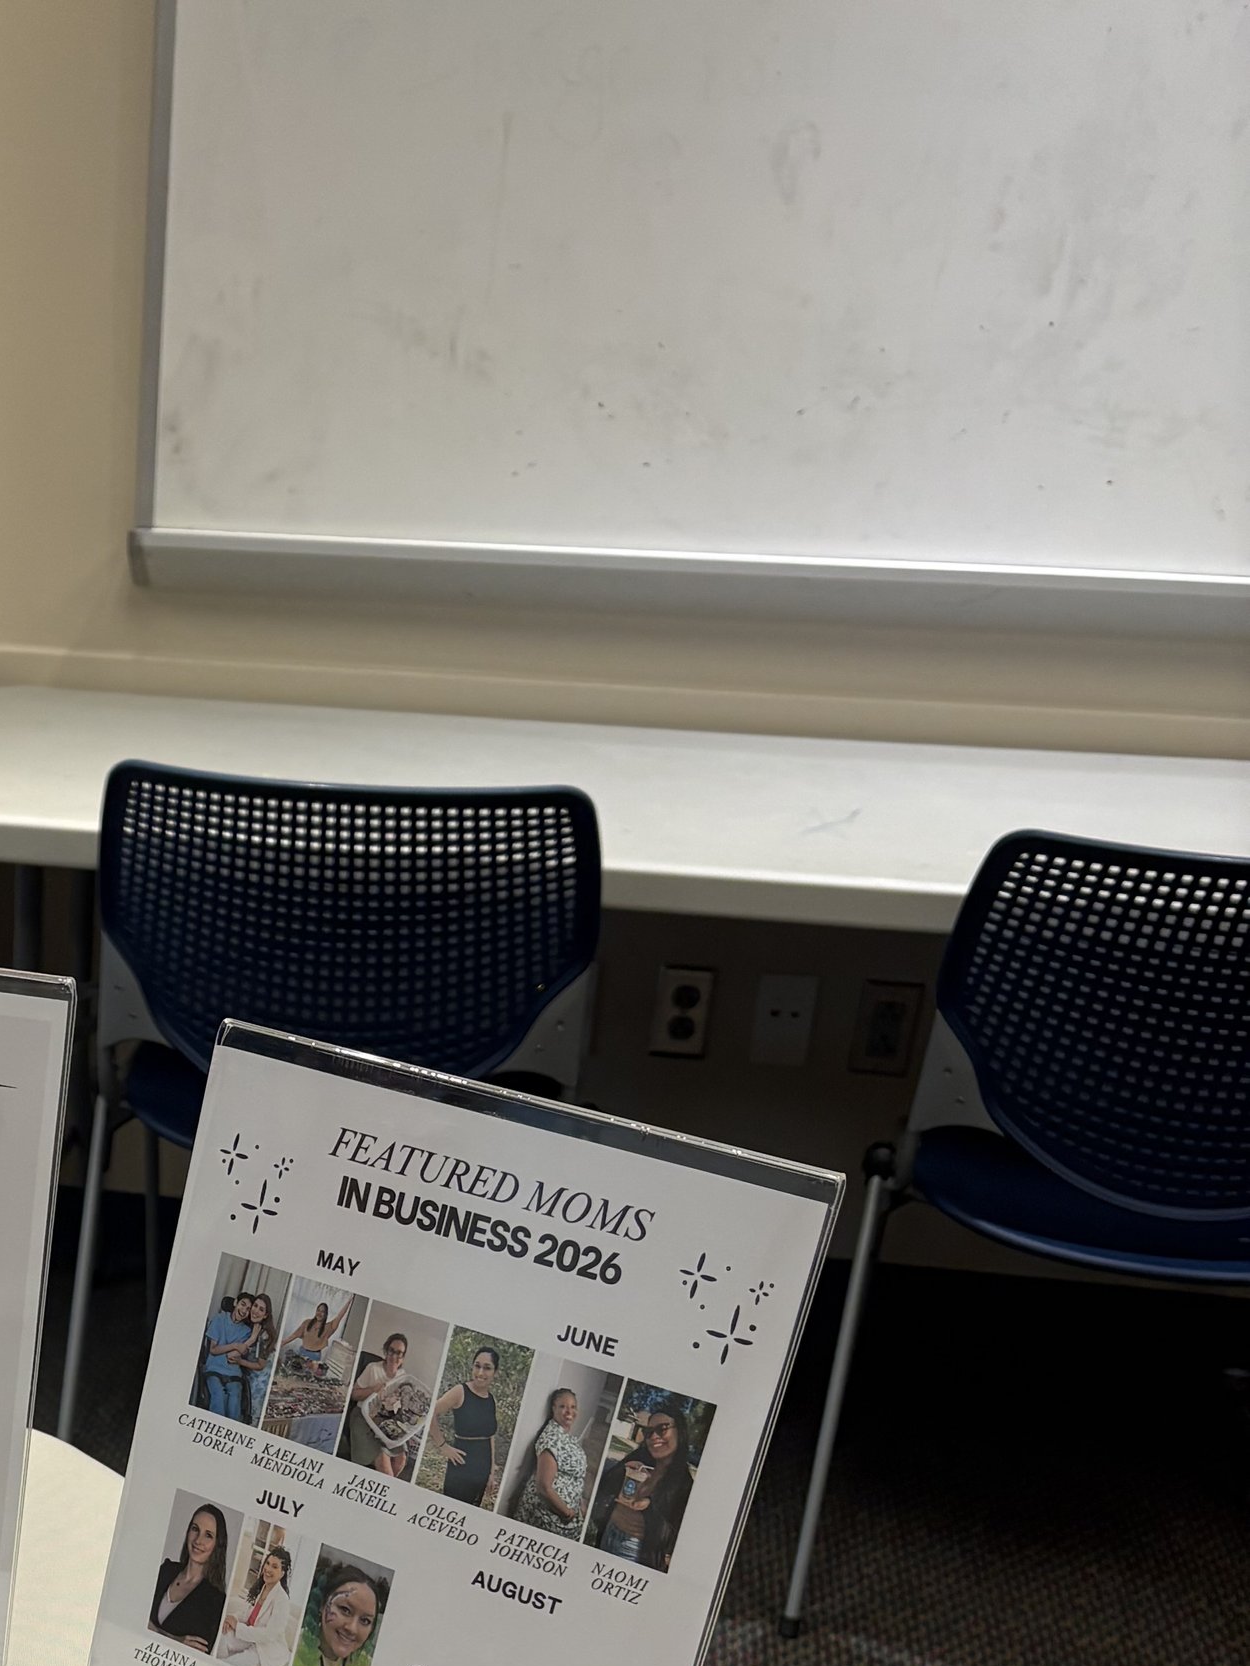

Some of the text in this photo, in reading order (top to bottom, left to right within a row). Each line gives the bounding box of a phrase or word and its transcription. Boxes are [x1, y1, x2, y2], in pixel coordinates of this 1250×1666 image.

[327, 1126, 656, 1242] FEATURED MOMS
[336, 1175, 622, 1285] IN BUSINESS 2026
[316, 1249, 361, 1277] MAY
[556, 1324, 619, 1357] JUNE
[178, 1413, 256, 1450] CATHERINE
[191, 1431, 234, 1456] DORIA
[249, 1453, 325, 1489] MENDIOLA
[261, 1442, 324, 1474] KAELANI
[331, 1482, 397, 1516] MCNEILL
[347, 1474, 390, 1497] JASIE
[255, 1489, 304, 1518] JULY
[425, 1503, 466, 1527] OLGA
[406, 1513, 479, 1546] ACEVEDO
[494, 1527, 570, 1564] PATRICIA
[489, 1542, 568, 1577] JOHNSON
[470, 1570, 563, 1614] AUGUST
[590, 1561, 649, 1592] NAOMI
[591, 1577, 642, 1605] ORTIZ
